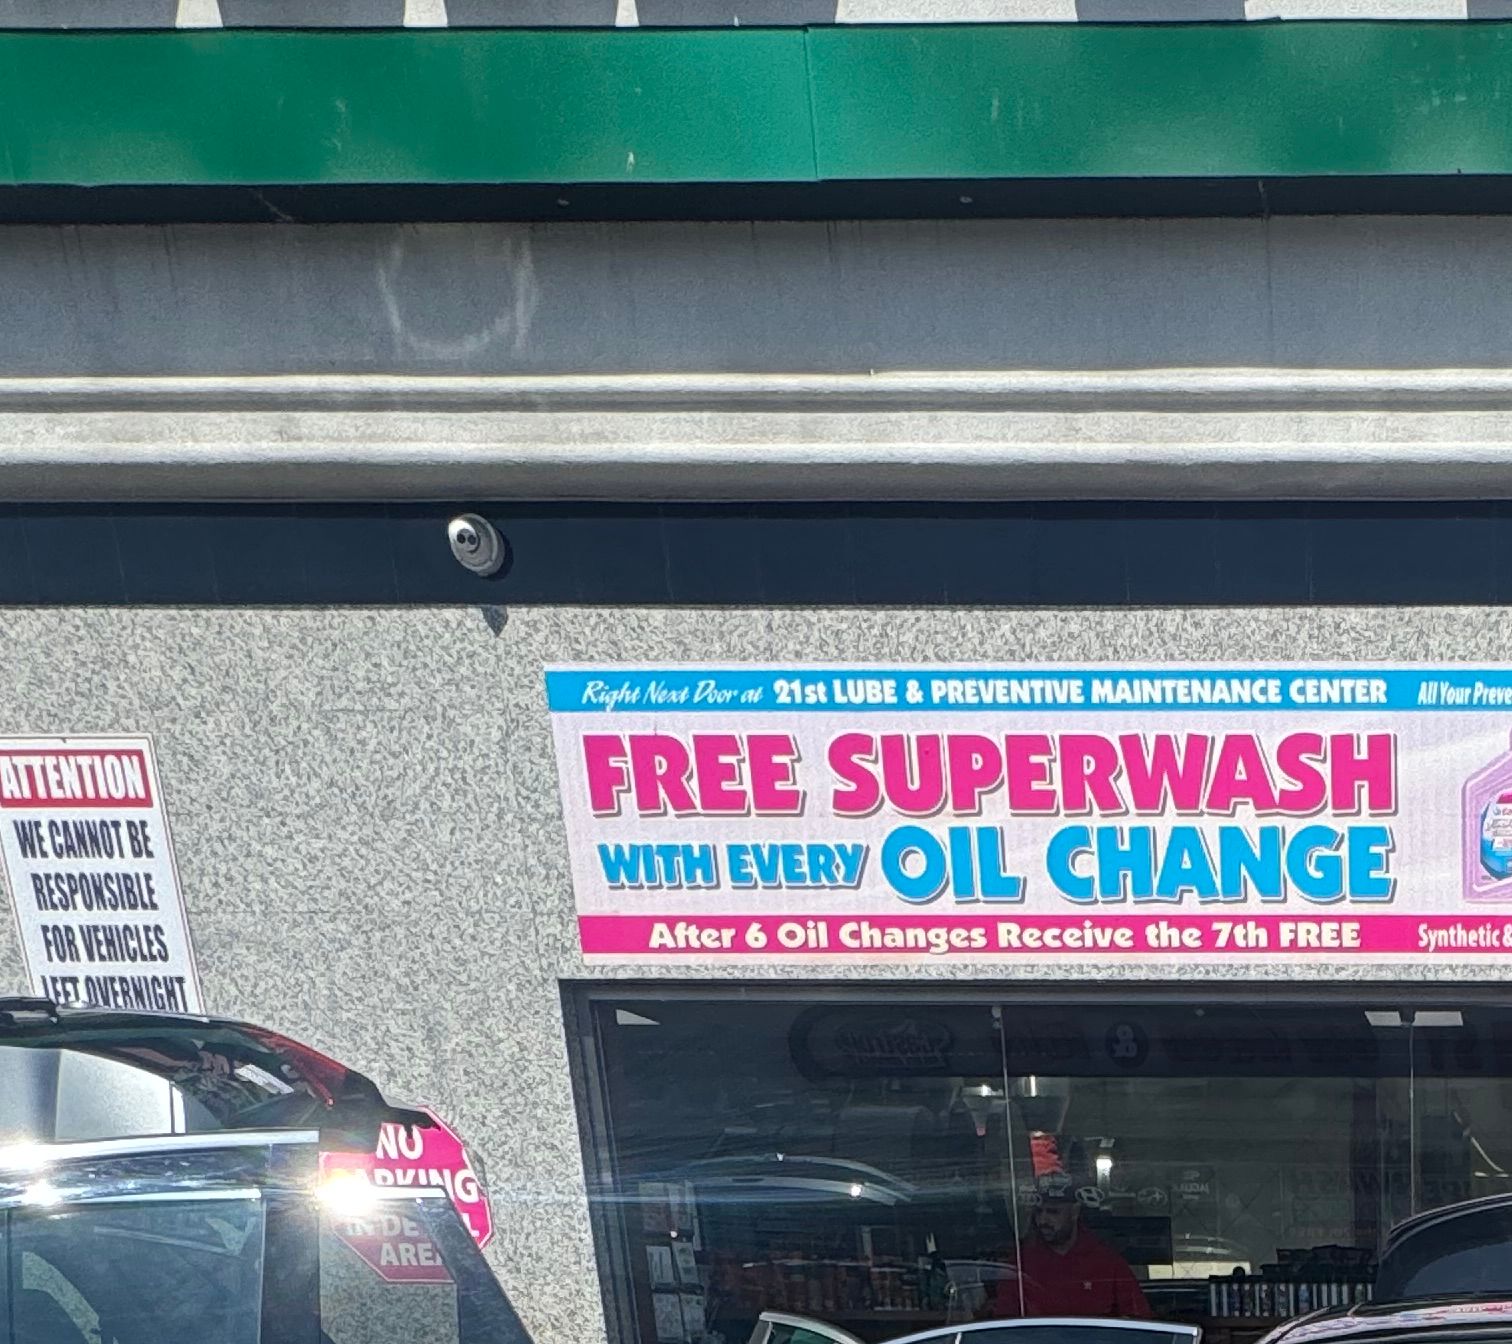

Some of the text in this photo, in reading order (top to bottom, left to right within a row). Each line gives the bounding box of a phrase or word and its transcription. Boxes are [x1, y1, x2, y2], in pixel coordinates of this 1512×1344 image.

[582, 679, 1387, 711] Right Next Door at 21st LUBE & PREVENTIVE MAINTENANCE CENTER
[1417, 681, 1438, 704] All
[1439, 681, 1473, 704] Your
[0, 754, 147, 801] ATTENTION
[583, 732, 1397, 817] FREE SUPERWASH
[13, 818, 155, 859] WE CANNOT BE
[597, 824, 1397, 906] WITH EVERY OIL CHANGE
[31, 871, 160, 912] RESPONSIBLE
[40, 923, 170, 963] FOR VEHICLES
[649, 920, 1361, 954] After 6 Oil Changes Receive the 7th FREE
[1417, 923, 1500, 953] Synthetic
[84, 975, 189, 1014] OVERNIGHT
[376, 1124, 424, 1161] NO
